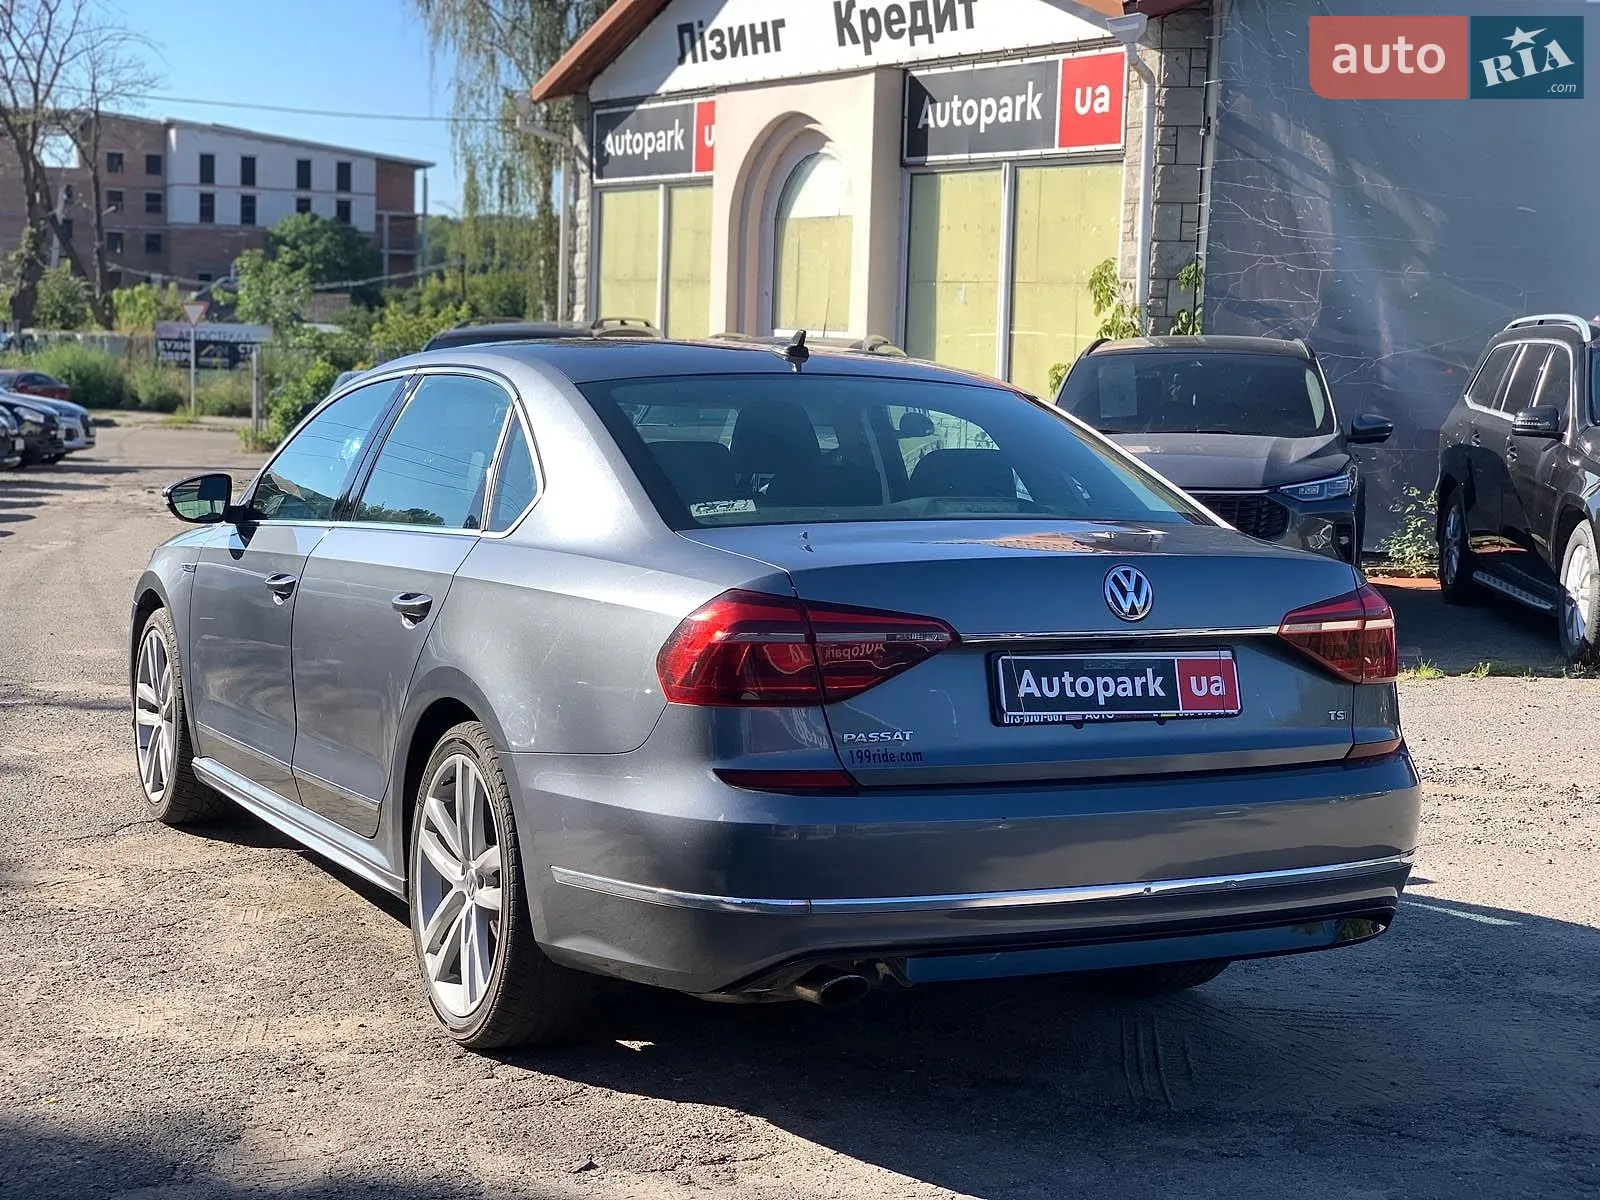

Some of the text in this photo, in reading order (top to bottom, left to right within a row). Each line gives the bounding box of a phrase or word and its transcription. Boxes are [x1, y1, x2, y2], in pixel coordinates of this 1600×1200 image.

[677, 0, 978, 65] Лізинг Кредит
[917, 81, 1110, 133] Autopark ua
[603, 119, 715, 160] Autopark u
[1018, 668, 1226, 705] Autopark ua
[1328, 710, 1348, 720] TSI
[843, 731, 913, 742] PASSAT
[849, 748, 923, 764] 199ride.com
